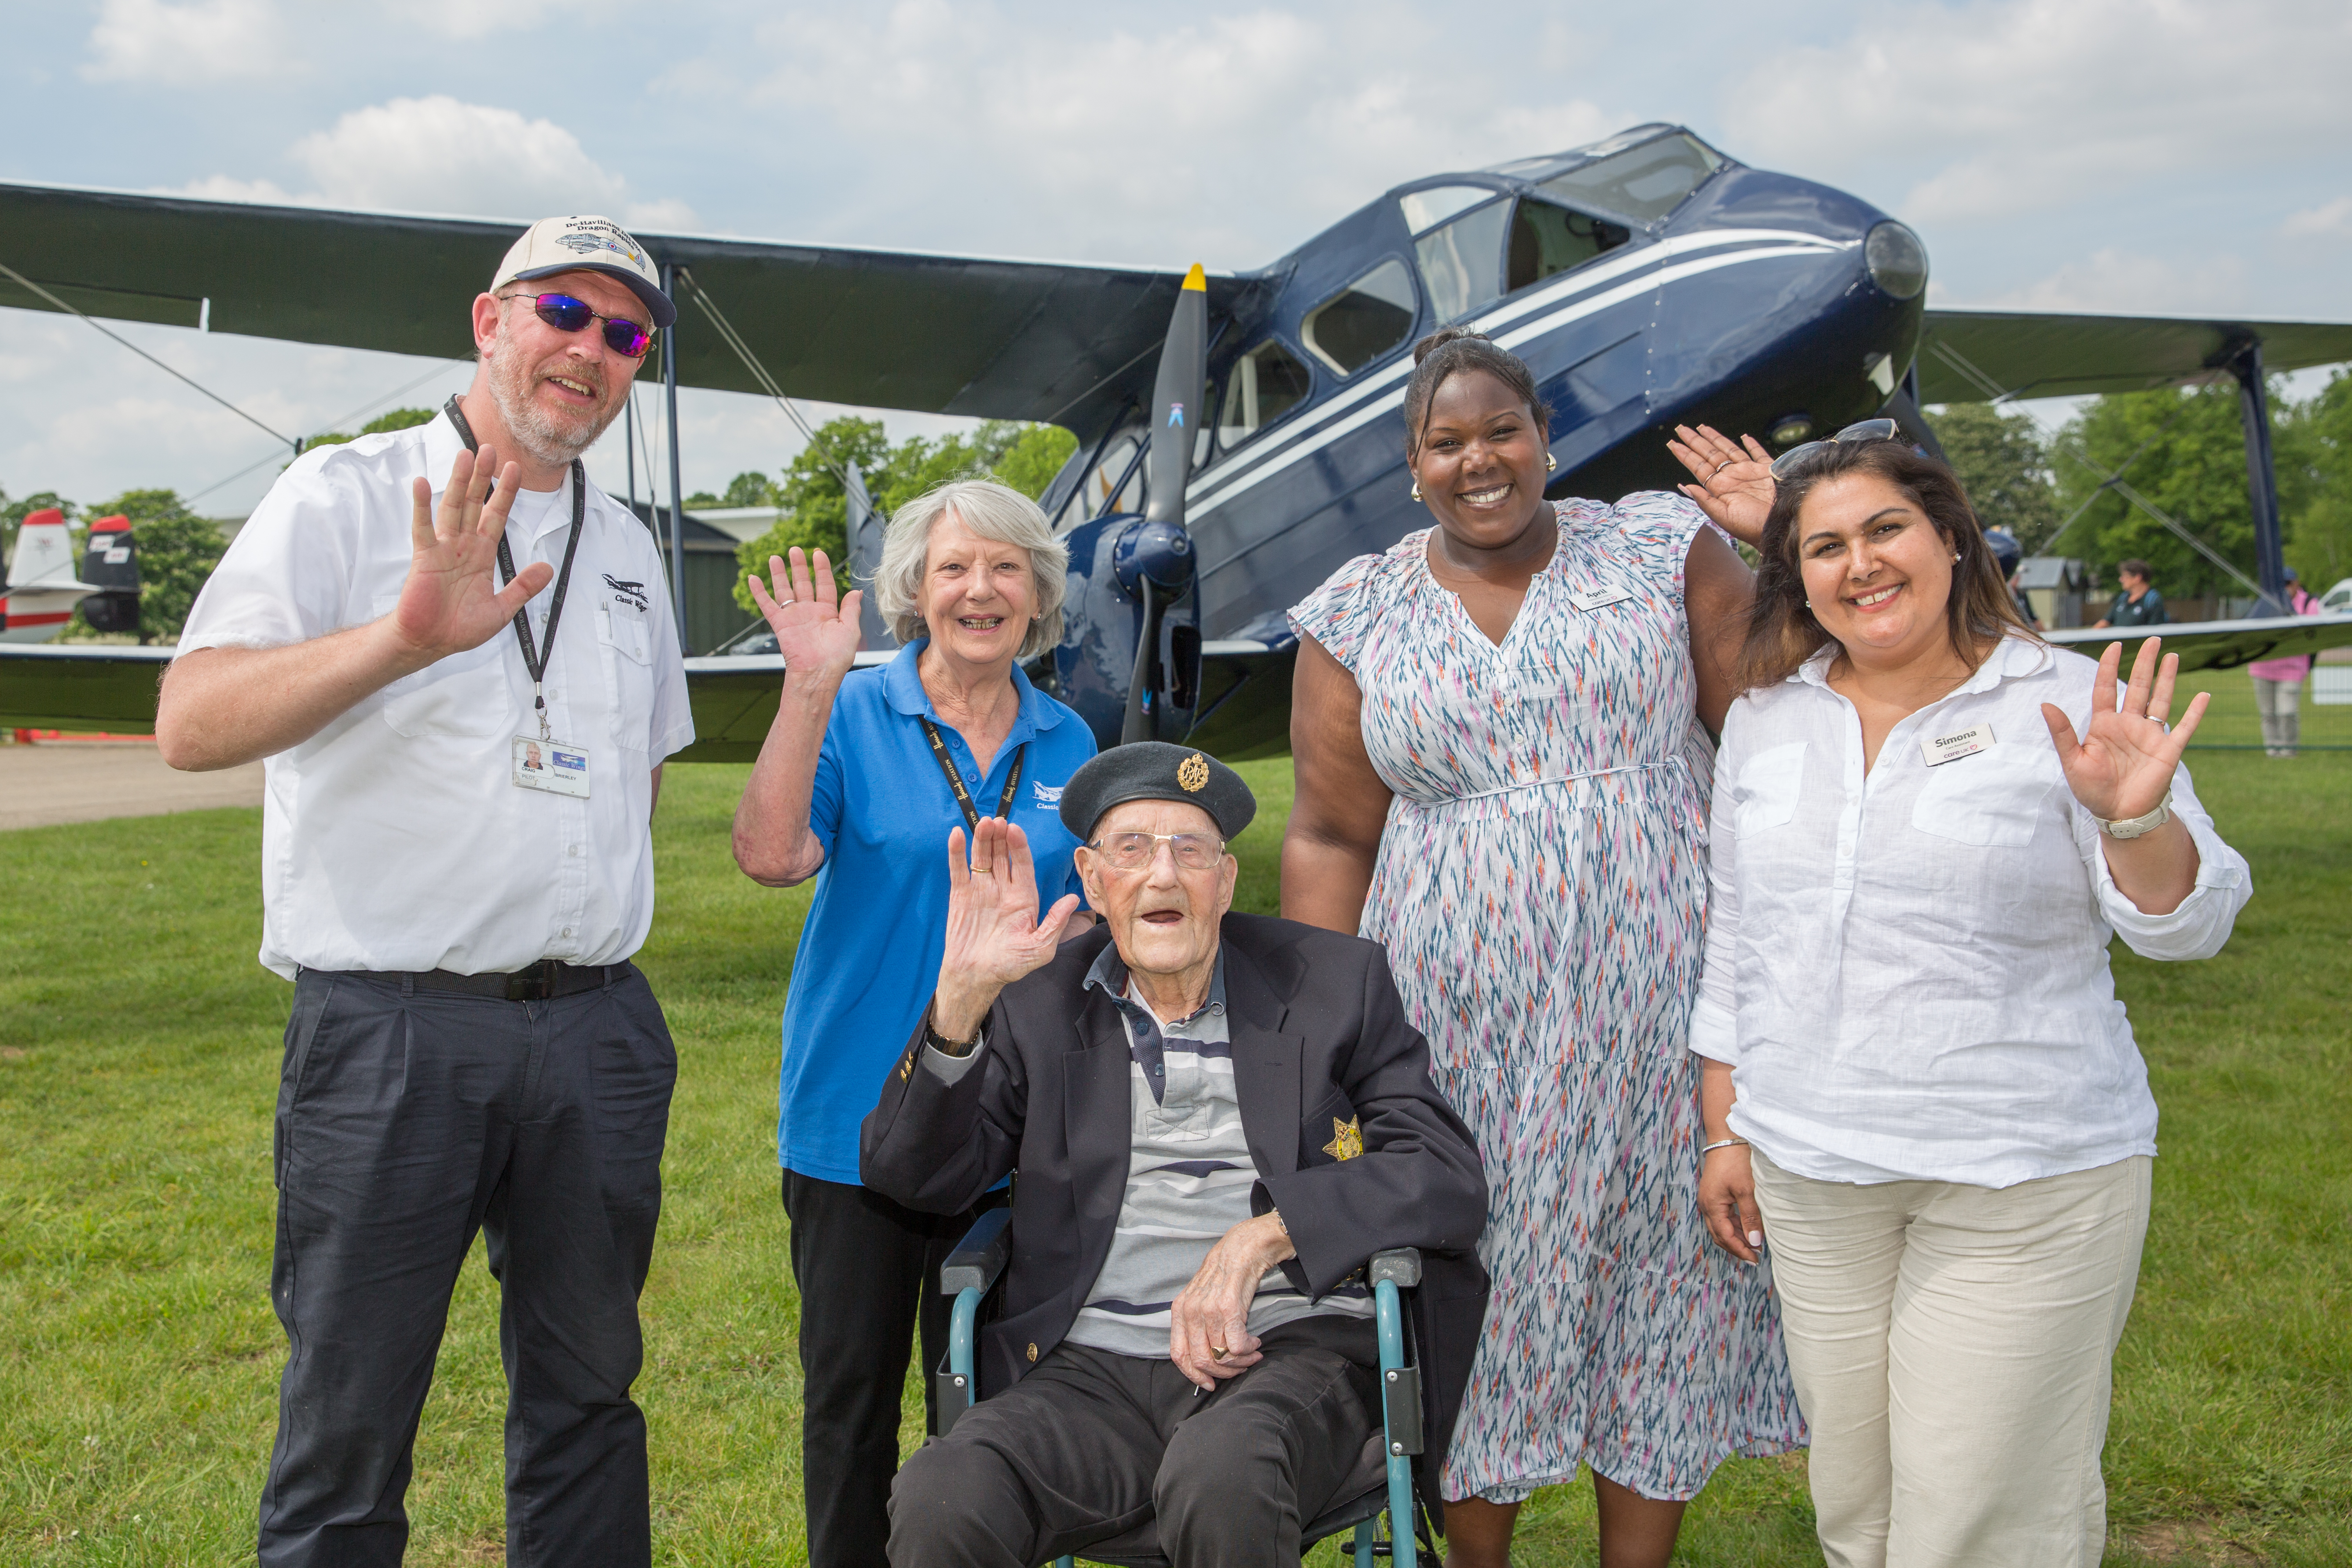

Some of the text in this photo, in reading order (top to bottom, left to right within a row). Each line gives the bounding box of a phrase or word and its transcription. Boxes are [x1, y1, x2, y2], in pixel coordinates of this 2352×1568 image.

[565, 220, 620, 231] De-Havilland
[612, 228, 634, 250] Rapide
[454, 413, 470, 434] AVIATION
[571, 524, 581, 545] Harrods
[500, 541, 512, 571] AVIATION
[554, 557, 572, 606] Harrods AVIATION
[615, 595, 633, 605] Classic
[1586, 589, 1607, 598] April
[517, 611, 536, 667] Harrods AVIATION
[548, 619, 558, 647] AVIATION
[930, 731, 944, 750] Harrods
[1935, 731, 1977, 748] Simona
[1944, 750, 1960, 758] care
[945, 759, 969, 801] Harrods AVIATION
[1002, 786, 1016, 803] Harrods
[1011, 765, 1020, 786] AVIATION
